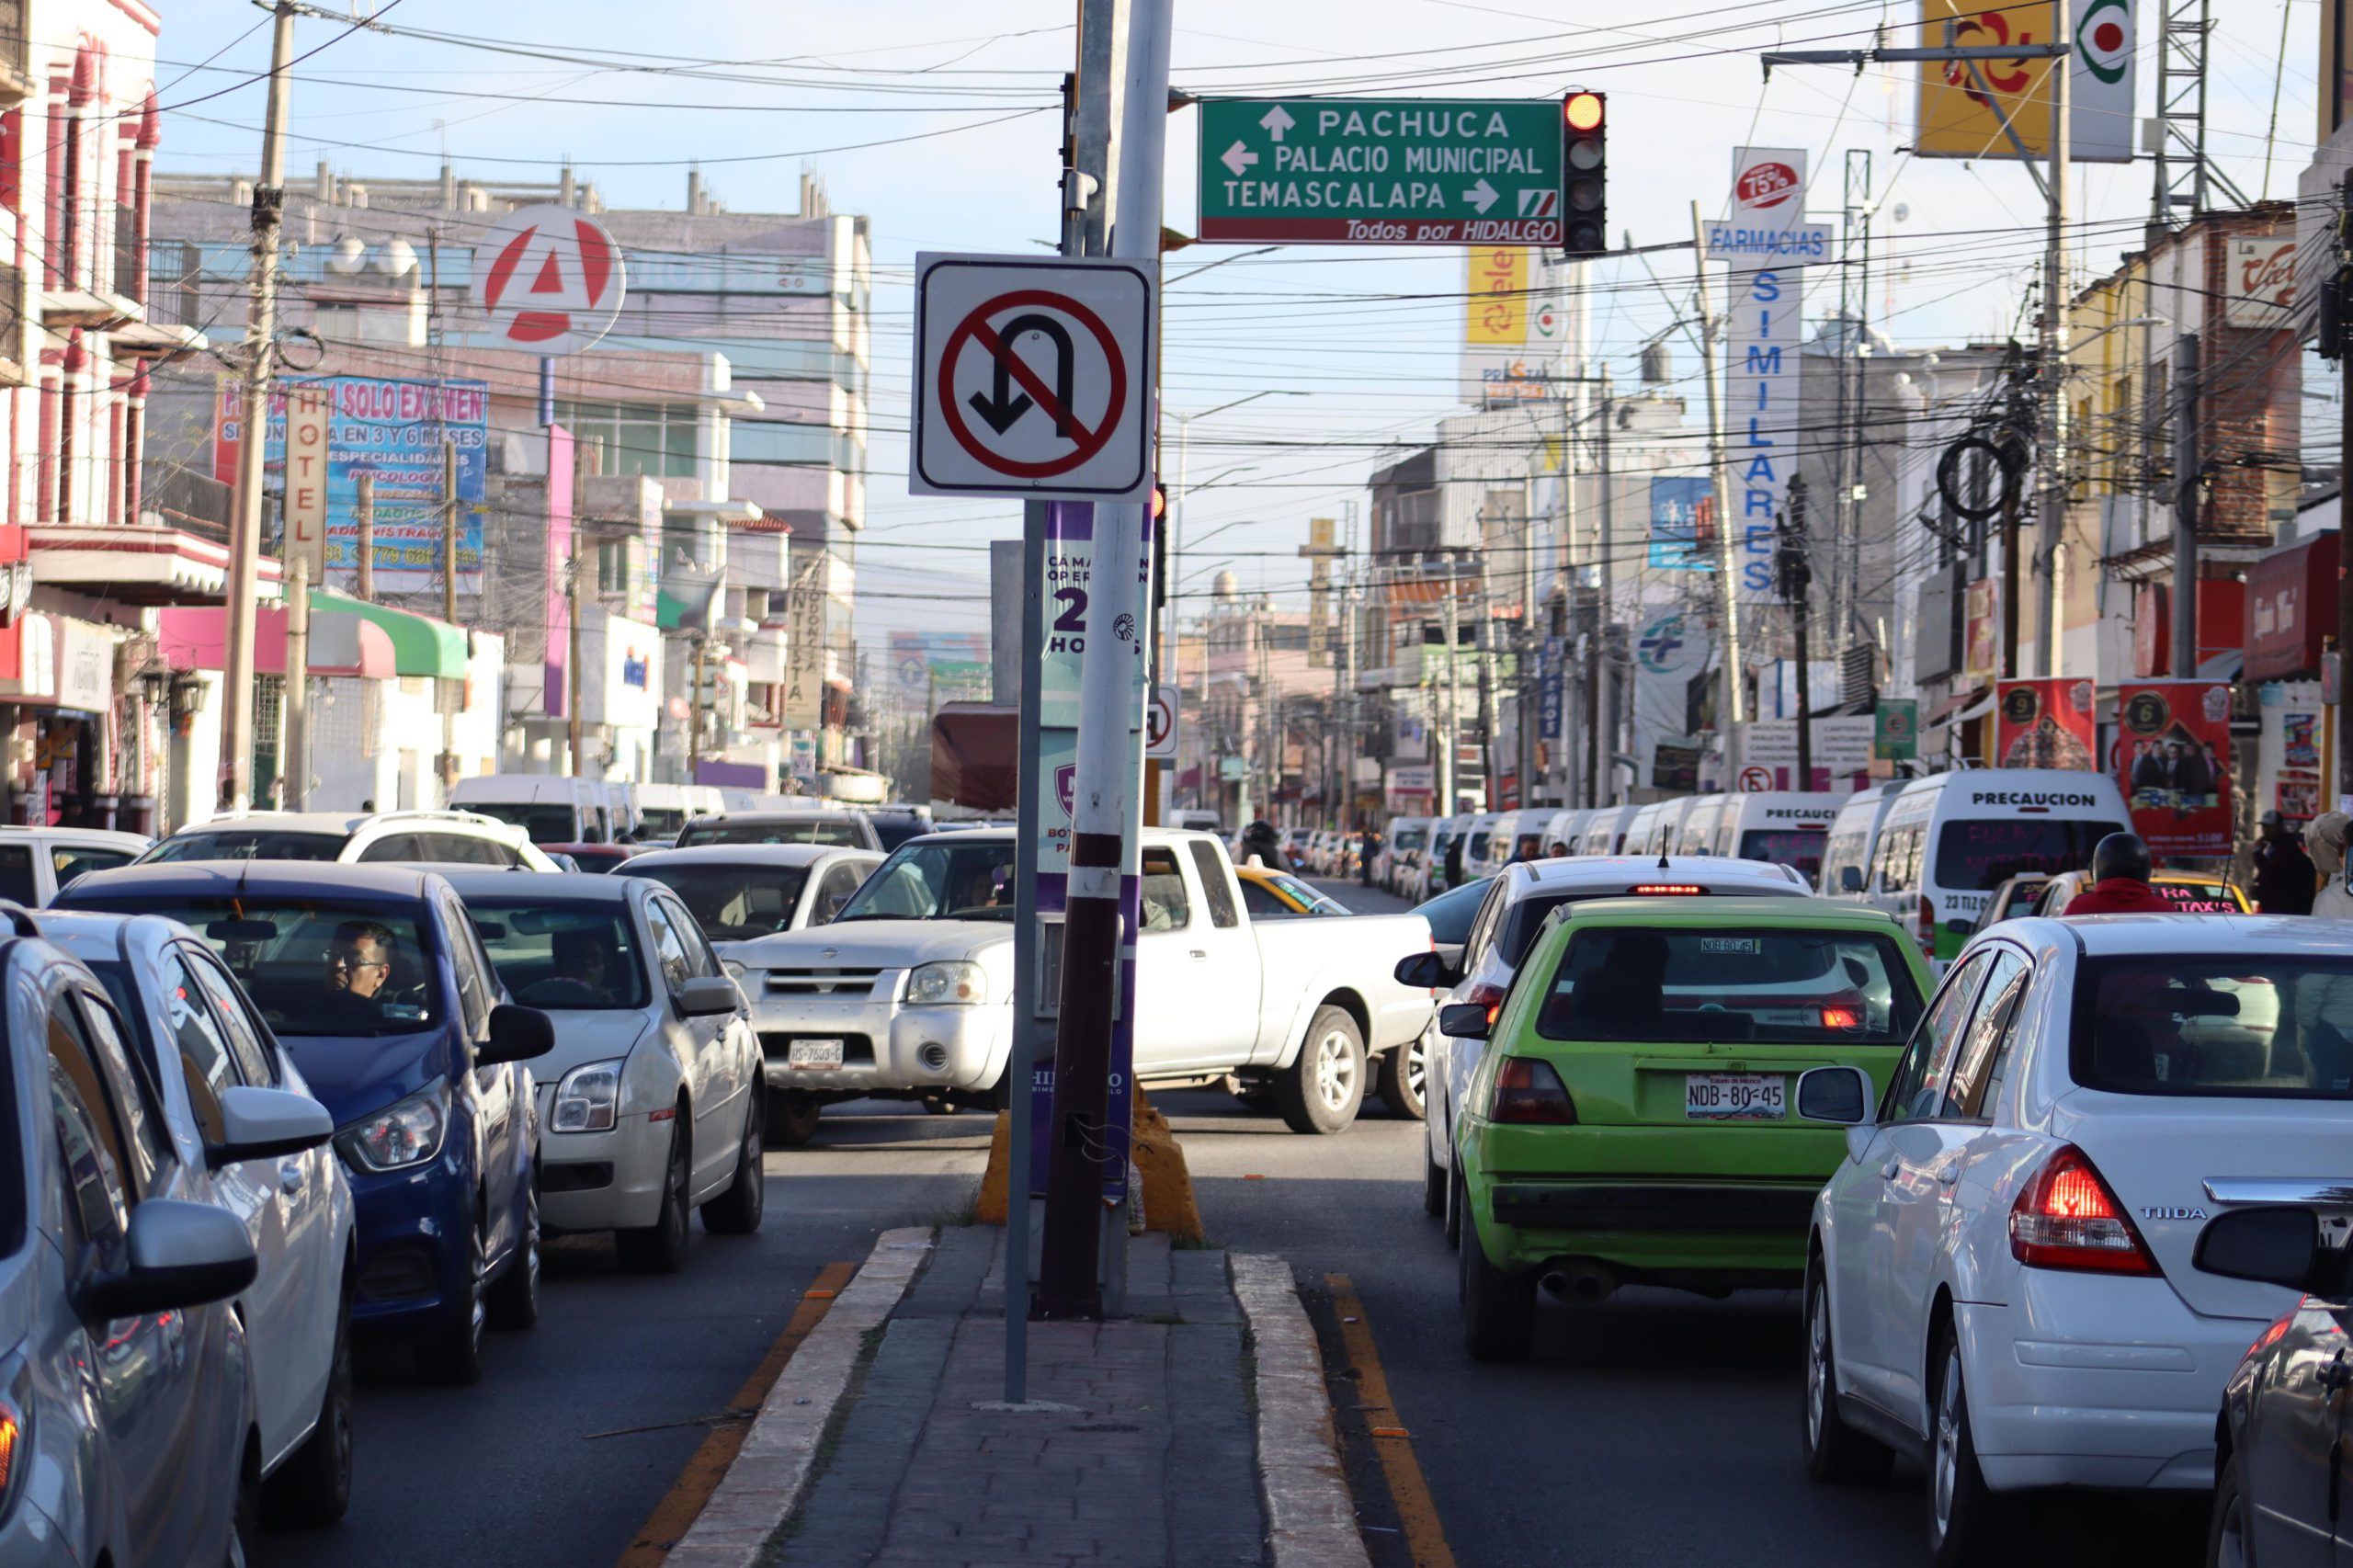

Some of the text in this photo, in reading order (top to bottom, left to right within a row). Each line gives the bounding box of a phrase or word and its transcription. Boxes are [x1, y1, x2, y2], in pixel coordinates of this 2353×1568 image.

[1317, 109, 1509, 138] PACHUCA
[1274, 145, 1543, 175] PALACIO MUNICIPAL
[1223, 180, 1446, 208] TEMASCALAPA
[1744, 169, 1790, 196] 75%
[1347, 220, 1557, 242] Todos por HIDALGO
[1711, 228, 1824, 256] FARMACIAS
[2238, 241, 2256, 255] La
[343, 382, 397, 421] SOLO
[400, 384, 483, 422] EXAMEN
[344, 426, 368, 443] EN
[373, 427, 384, 443] 3
[386, 428, 401, 444] Y
[405, 428, 417, 444] 6
[1743, 272, 1781, 592] SIMILARES
[296, 392, 320, 542] HOTEL
[1972, 791, 2097, 807] PRECAUCION
[1945, 894, 1959, 910] 23
[1702, 939, 1753, 952] NDB-80-45
[1688, 1085, 1783, 1107] NDB-80-45
[2139, 1206, 2207, 1220] TIIDA
